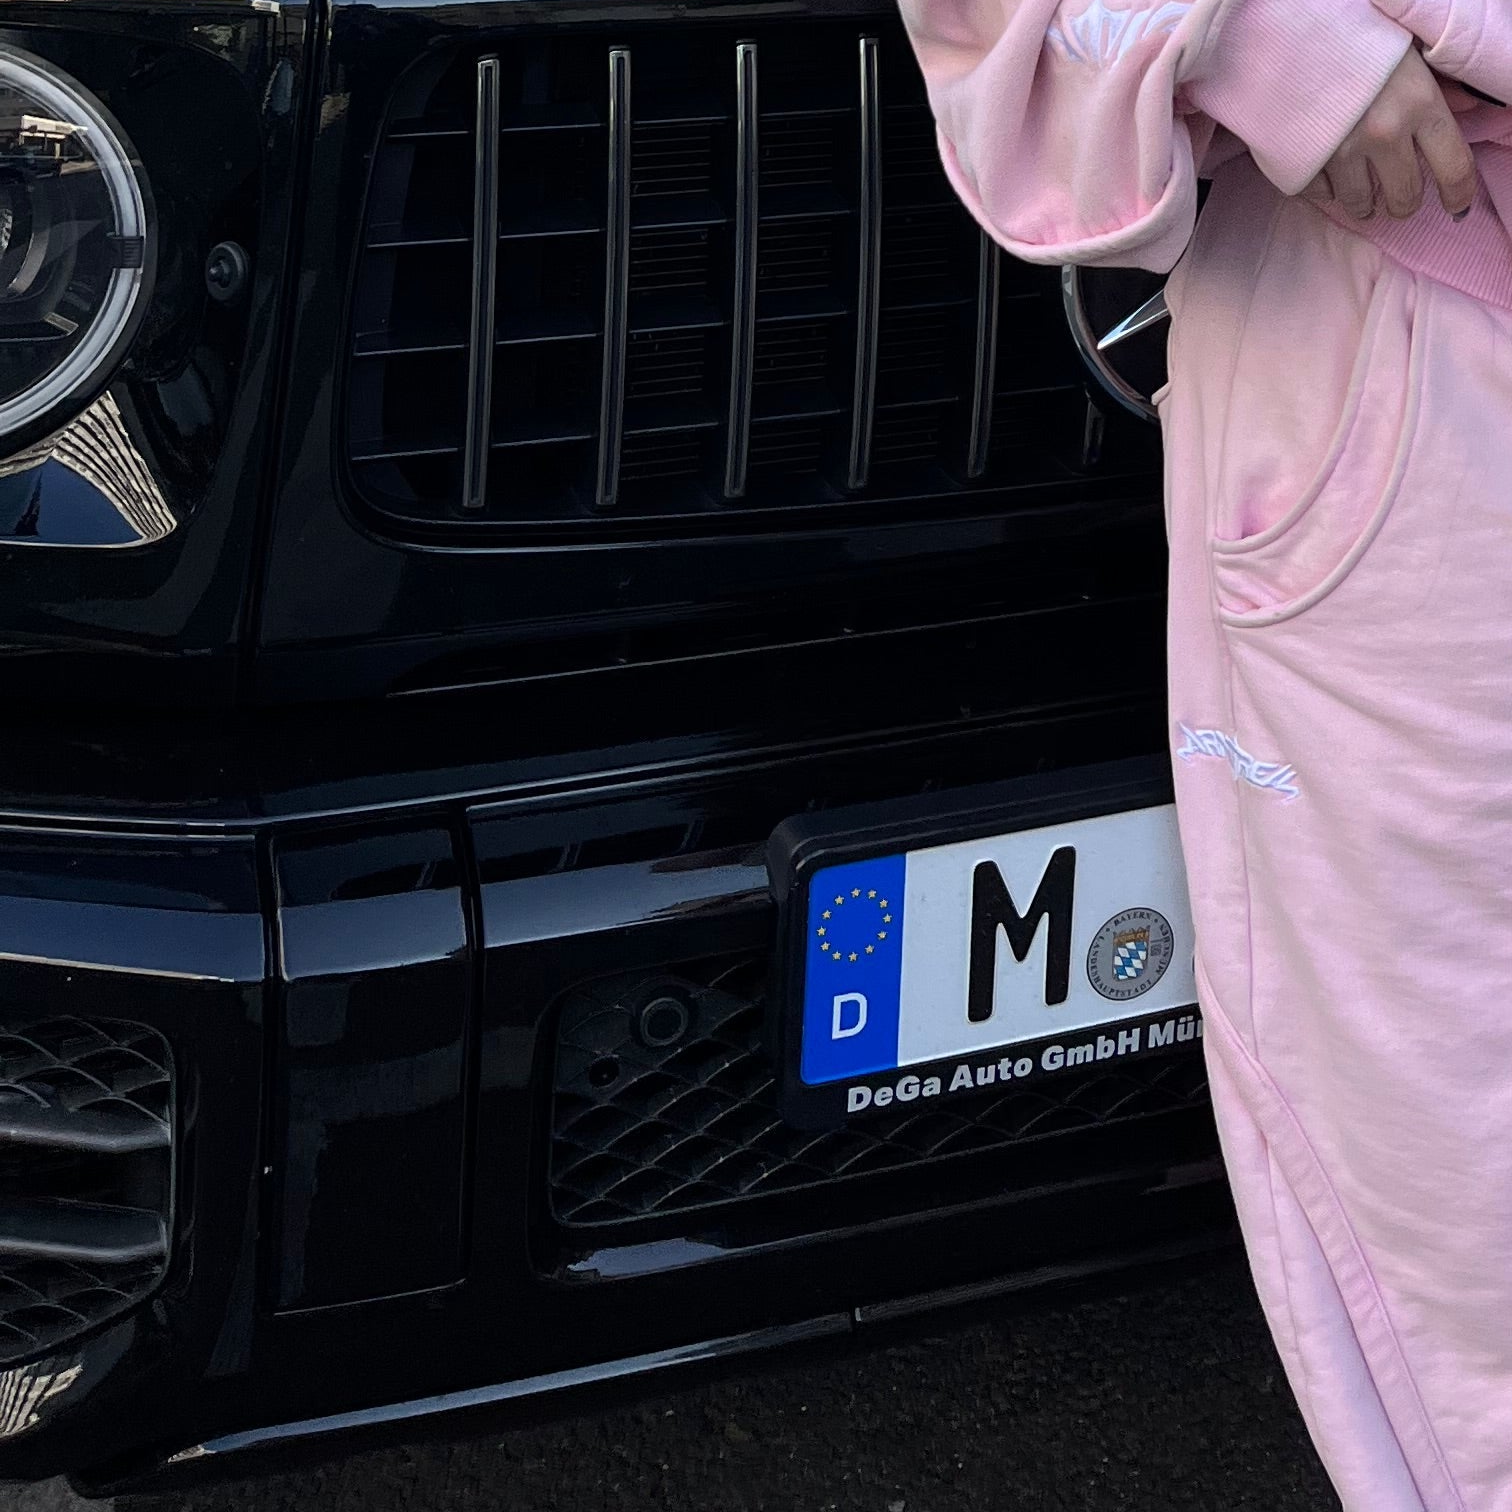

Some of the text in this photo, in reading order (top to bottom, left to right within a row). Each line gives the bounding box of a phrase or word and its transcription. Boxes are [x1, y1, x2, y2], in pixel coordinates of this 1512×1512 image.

[967, 846, 1076, 1023] M
[1113, 911, 1152, 926] BAYERN
[831, 992, 868, 1040] D
[847, 1074, 940, 1113] DeGa
[949, 1057, 1032, 1092] Auto
[1042, 1027, 1140, 1071] GmbH
